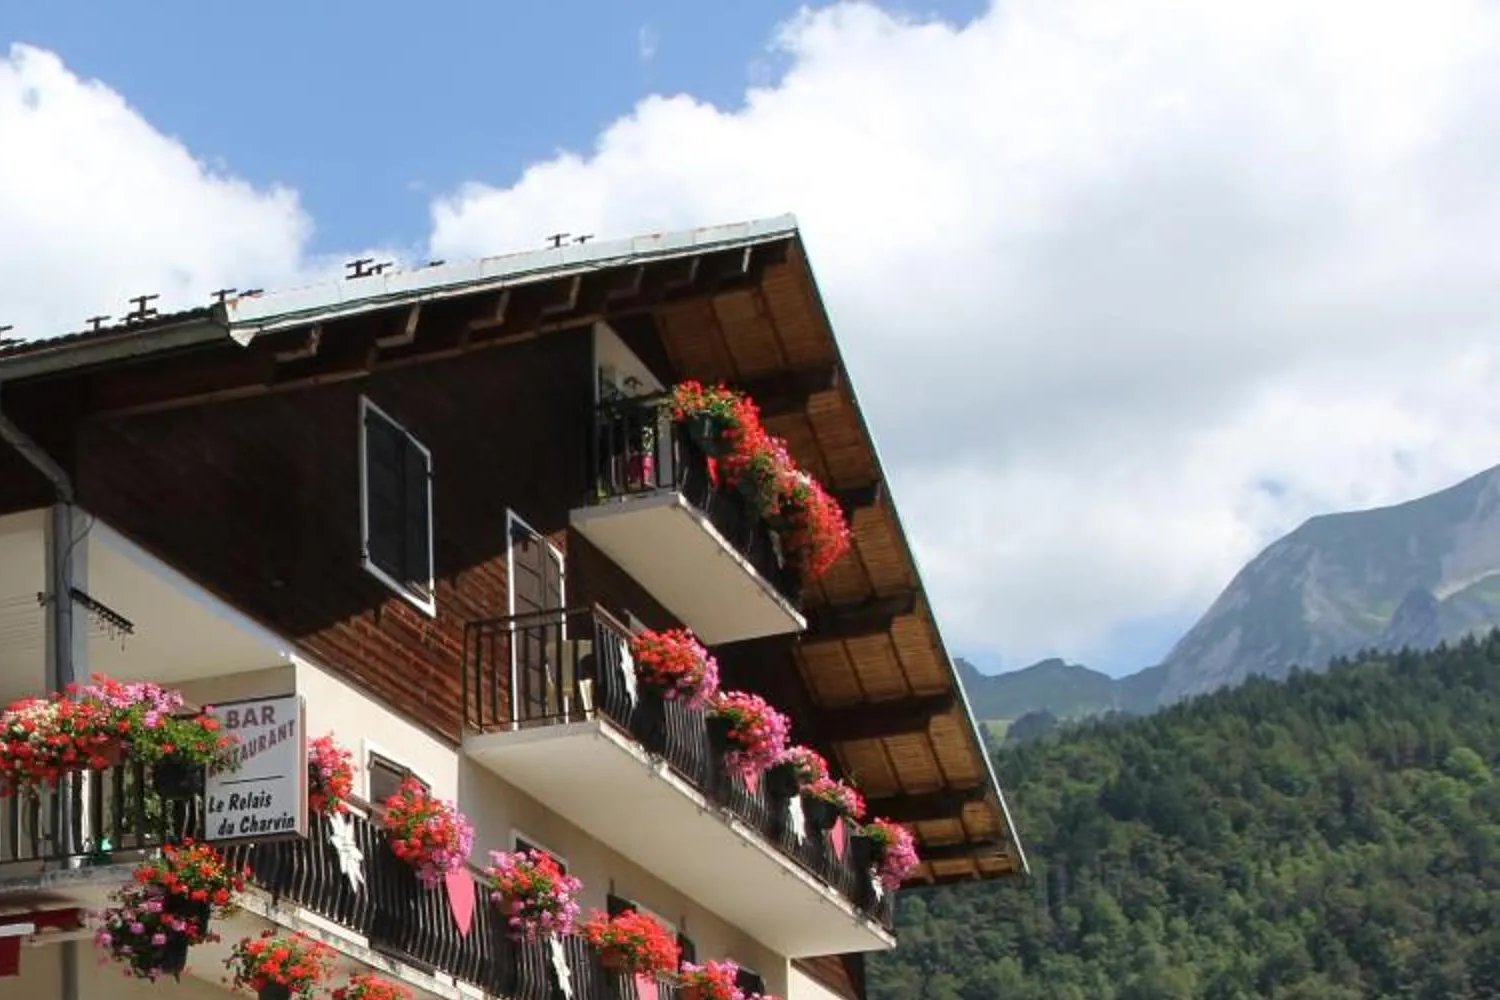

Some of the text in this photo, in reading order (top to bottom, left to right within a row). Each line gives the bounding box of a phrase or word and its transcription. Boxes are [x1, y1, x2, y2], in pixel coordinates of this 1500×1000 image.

[226, 705, 276, 729] BAR
[208, 790, 272, 813] Le Relais
[218, 811, 295, 835] du Charvin
